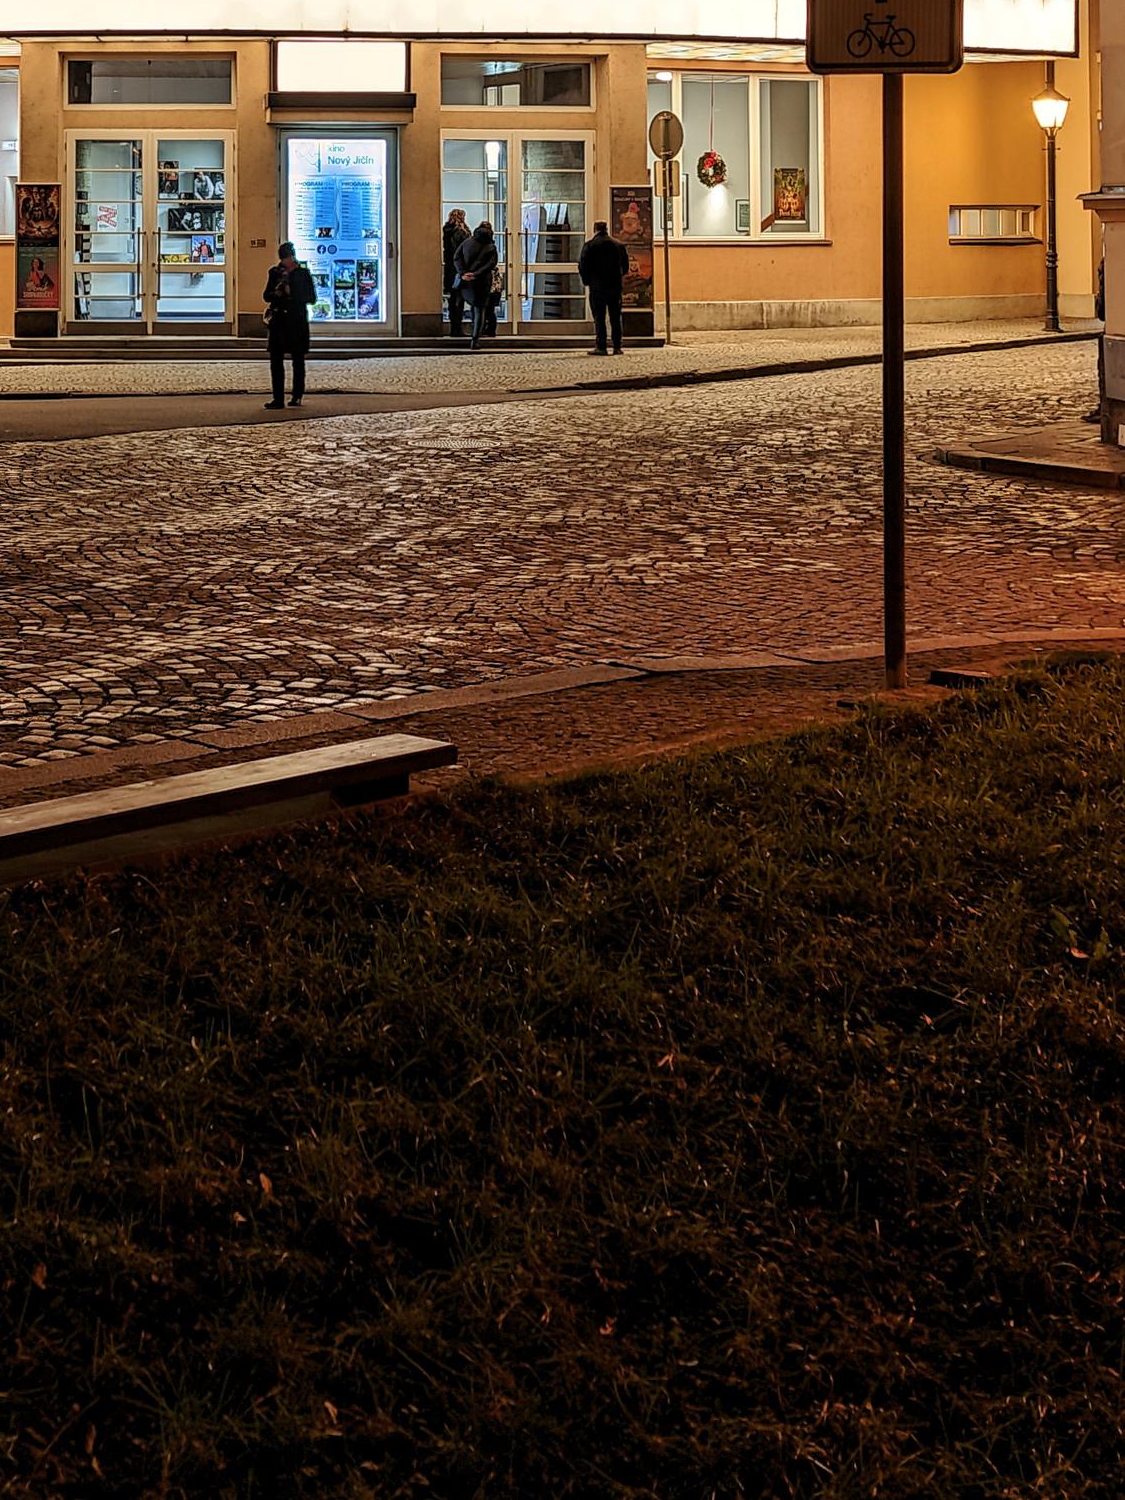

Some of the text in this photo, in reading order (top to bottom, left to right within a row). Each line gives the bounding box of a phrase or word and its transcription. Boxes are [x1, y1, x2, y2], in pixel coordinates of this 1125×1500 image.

[328, 144, 346, 153] kino
[327, 155, 374, 166] Nový Jičín
